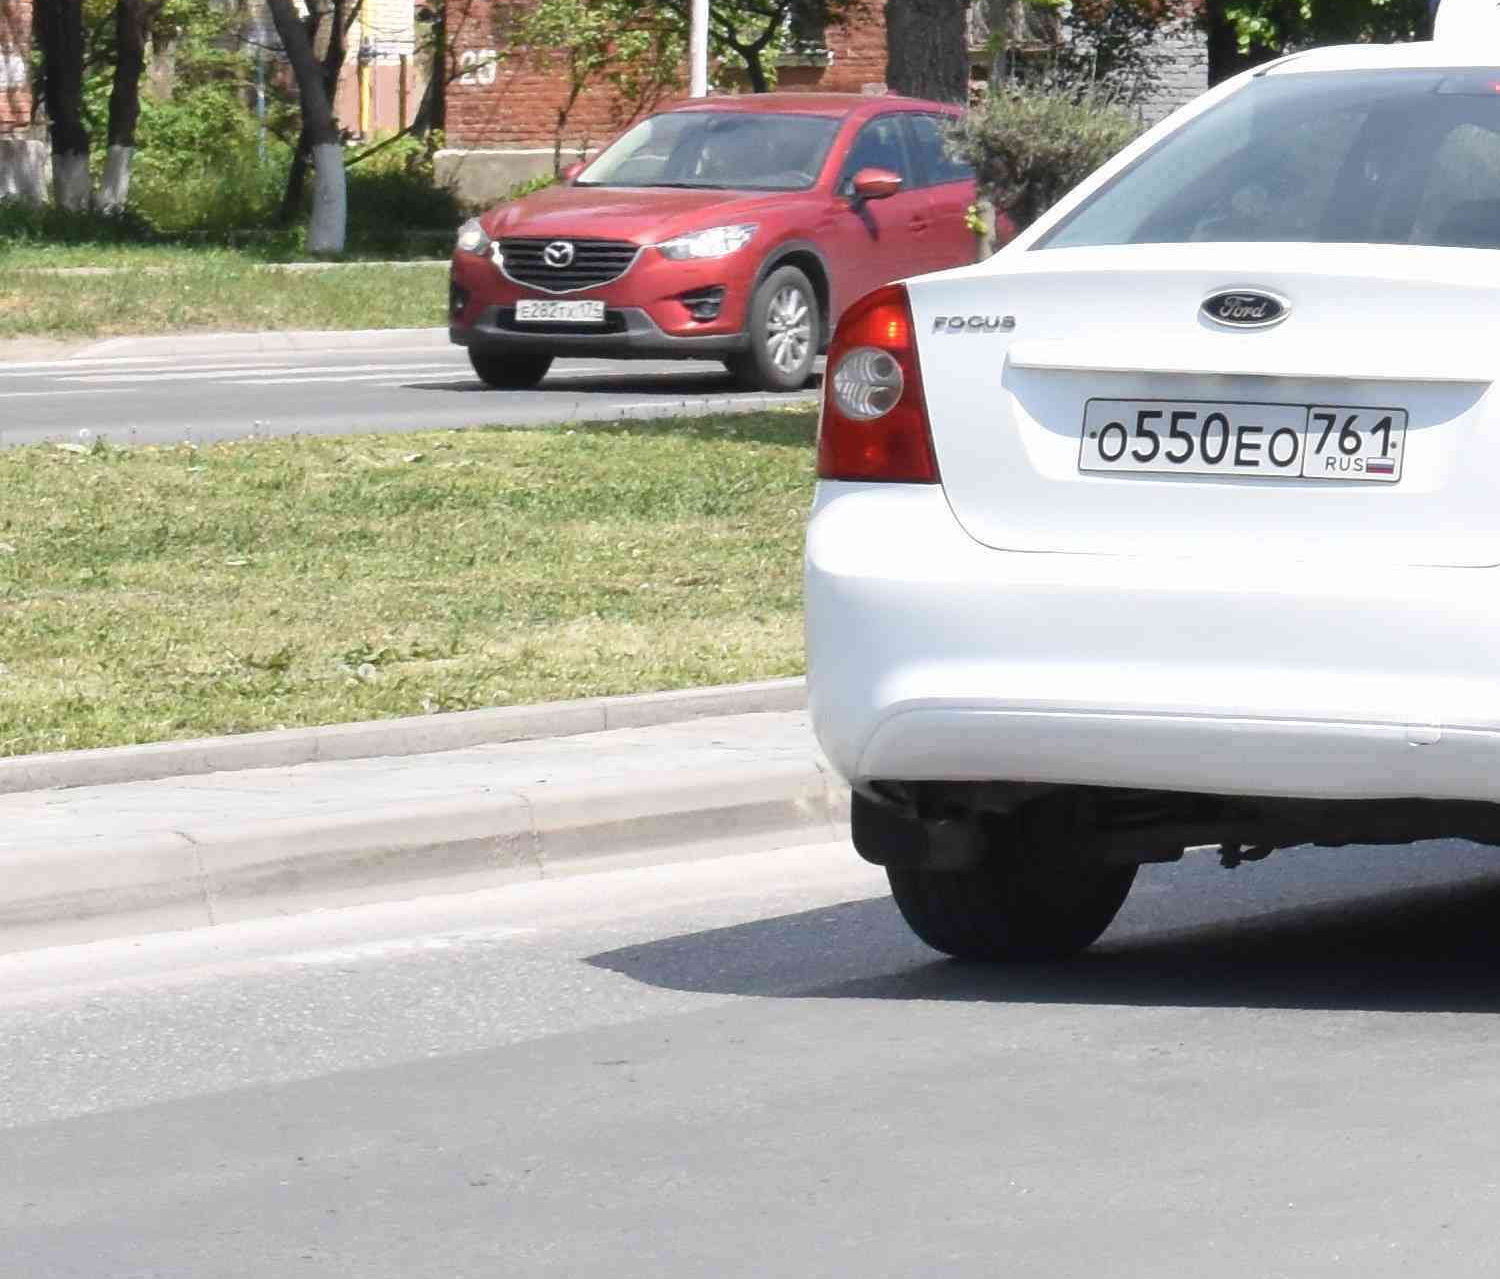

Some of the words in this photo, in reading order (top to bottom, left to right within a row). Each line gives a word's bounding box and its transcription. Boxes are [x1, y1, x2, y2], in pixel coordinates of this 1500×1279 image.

[1219, 296, 1268, 318] Ford
[932, 314, 1018, 331] FOCUS
[1096, 409, 1300, 469] О550ЕО
[1313, 411, 1394, 458] 761
[1324, 455, 1366, 473] RUS
